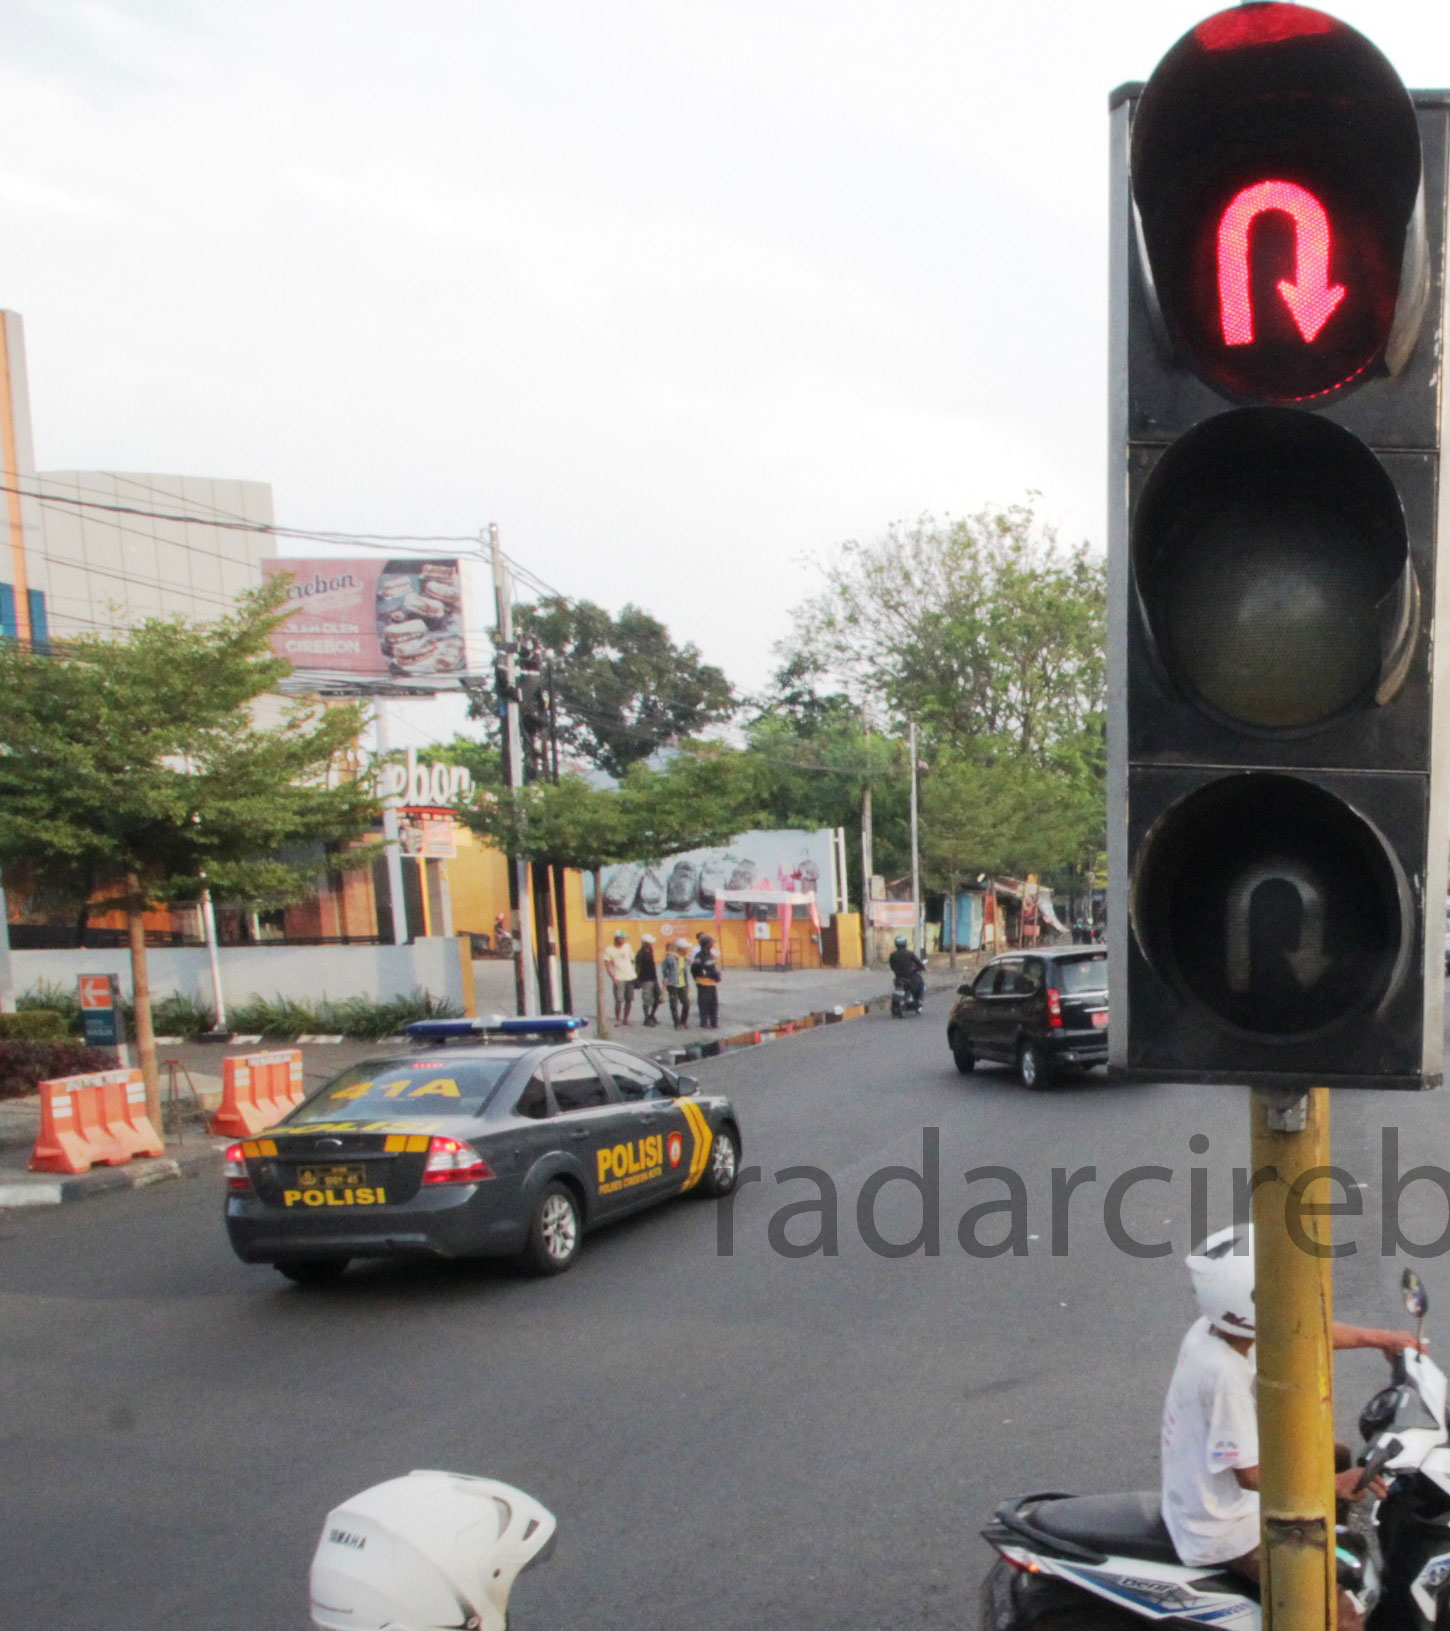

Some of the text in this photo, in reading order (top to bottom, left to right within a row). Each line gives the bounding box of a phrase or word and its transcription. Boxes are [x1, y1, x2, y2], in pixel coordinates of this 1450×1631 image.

[285, 639, 361, 655] CIREBON
[329, 1079, 462, 1101] 41A
[596, 1133, 664, 1183] POLISI
[283, 1186, 387, 1208] POLISI
